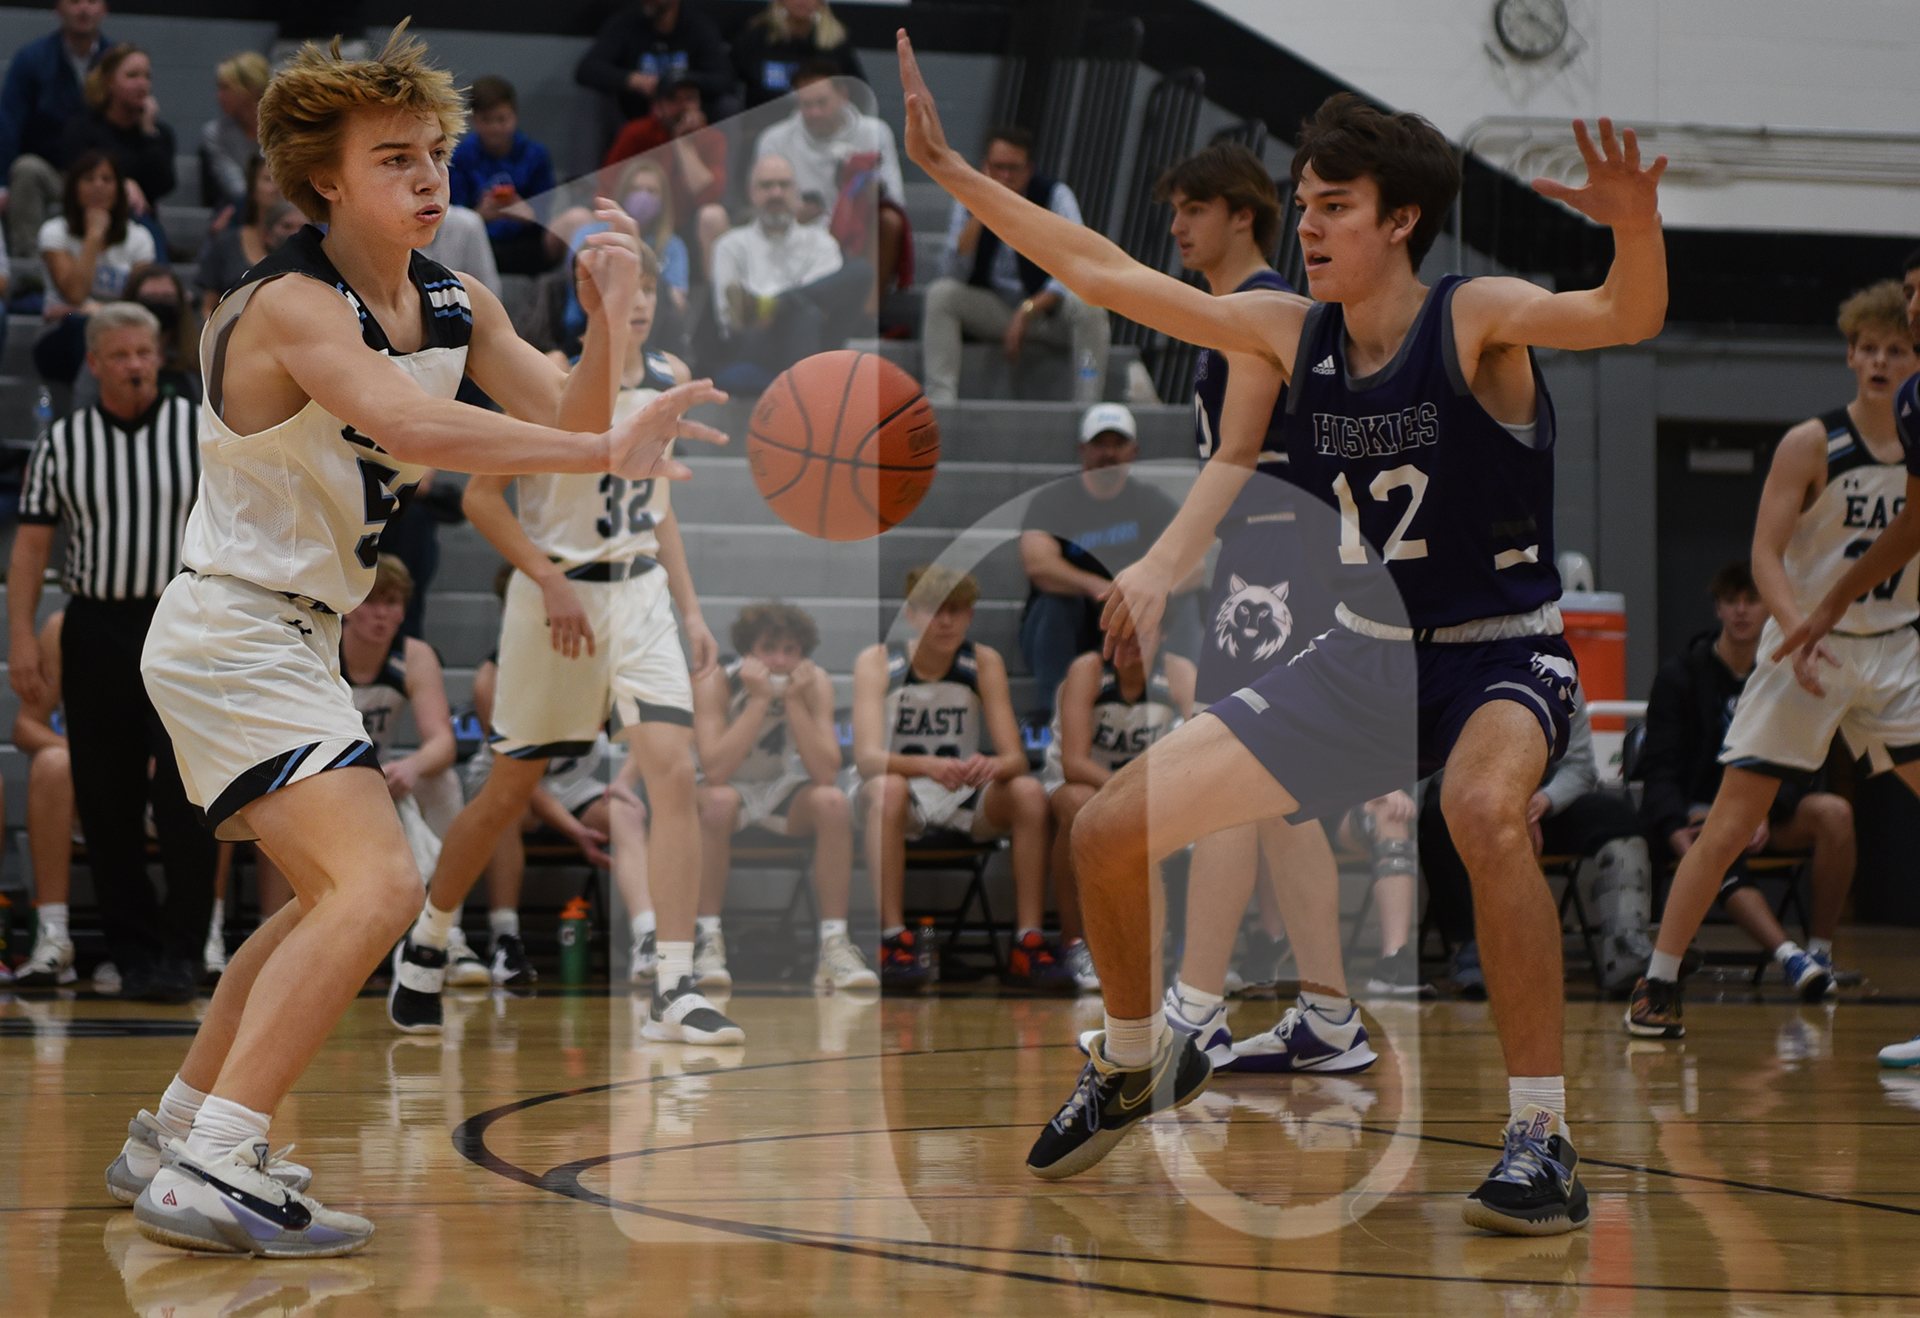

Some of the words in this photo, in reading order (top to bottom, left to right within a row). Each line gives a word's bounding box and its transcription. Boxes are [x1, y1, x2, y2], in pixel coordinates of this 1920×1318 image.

[596, 473, 657, 539] 32
[1331, 463, 1430, 565] 12
[895, 707, 968, 735] EAST
[1092, 722, 1164, 753] EAST
